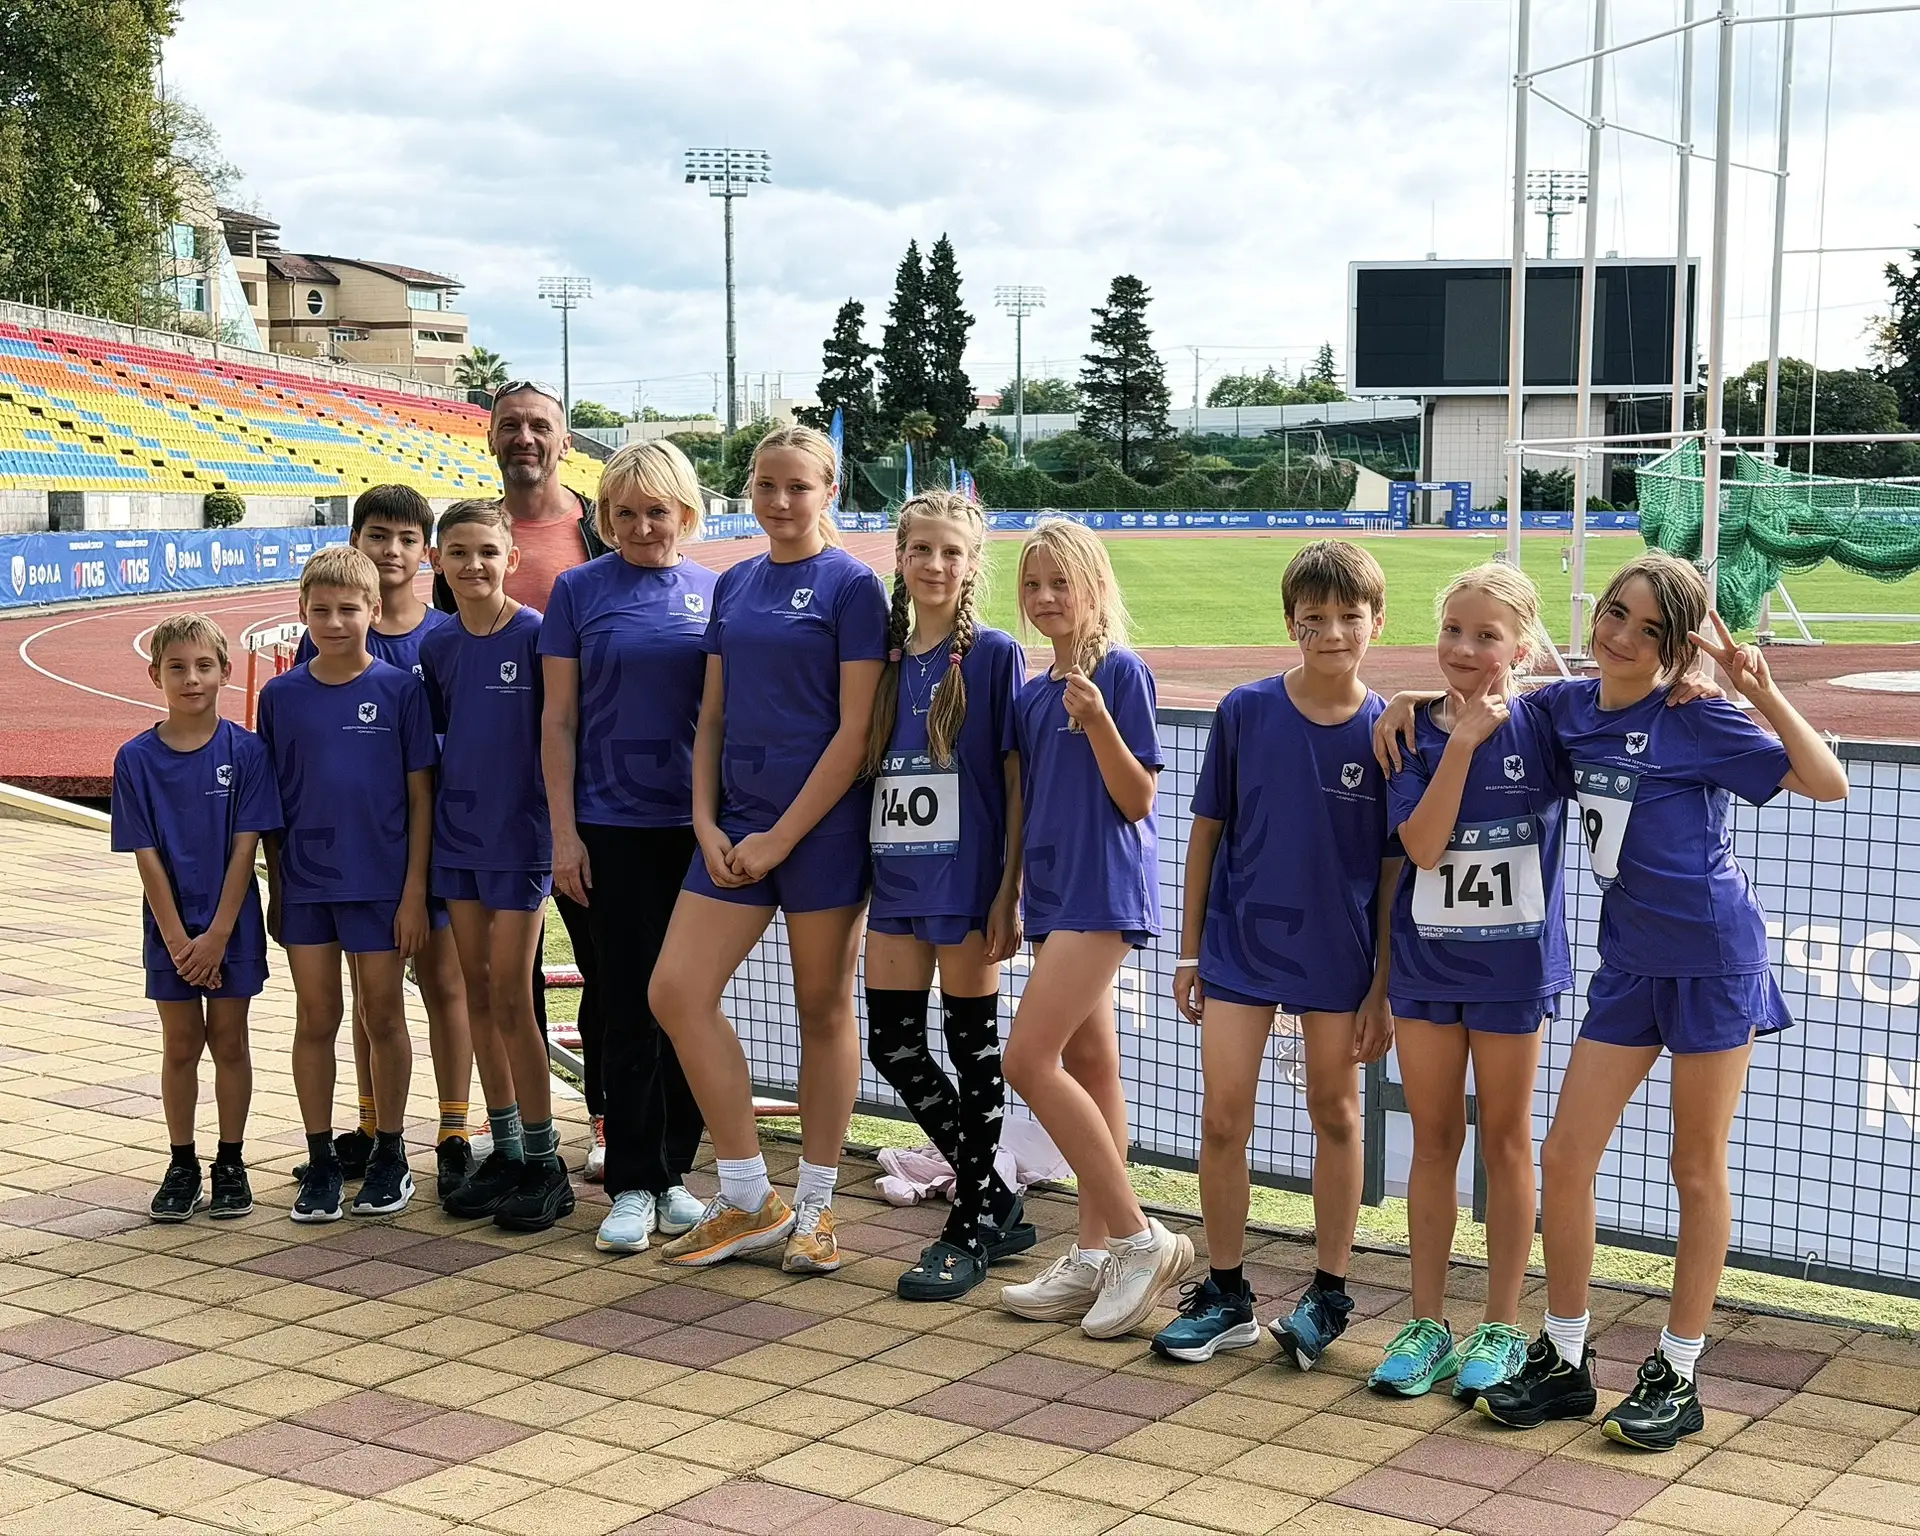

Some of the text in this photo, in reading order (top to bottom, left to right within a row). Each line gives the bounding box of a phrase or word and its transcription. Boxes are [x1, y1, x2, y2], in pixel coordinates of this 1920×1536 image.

[178, 550, 202, 569] ВФЛА
[222, 549, 245, 566] ВФЛА
[29, 563, 61, 585] ВФЛА
[880, 786, 939, 827] 140
[1439, 861, 1514, 909] 141
[1416, 924, 1463, 934] ШИПОВКА
